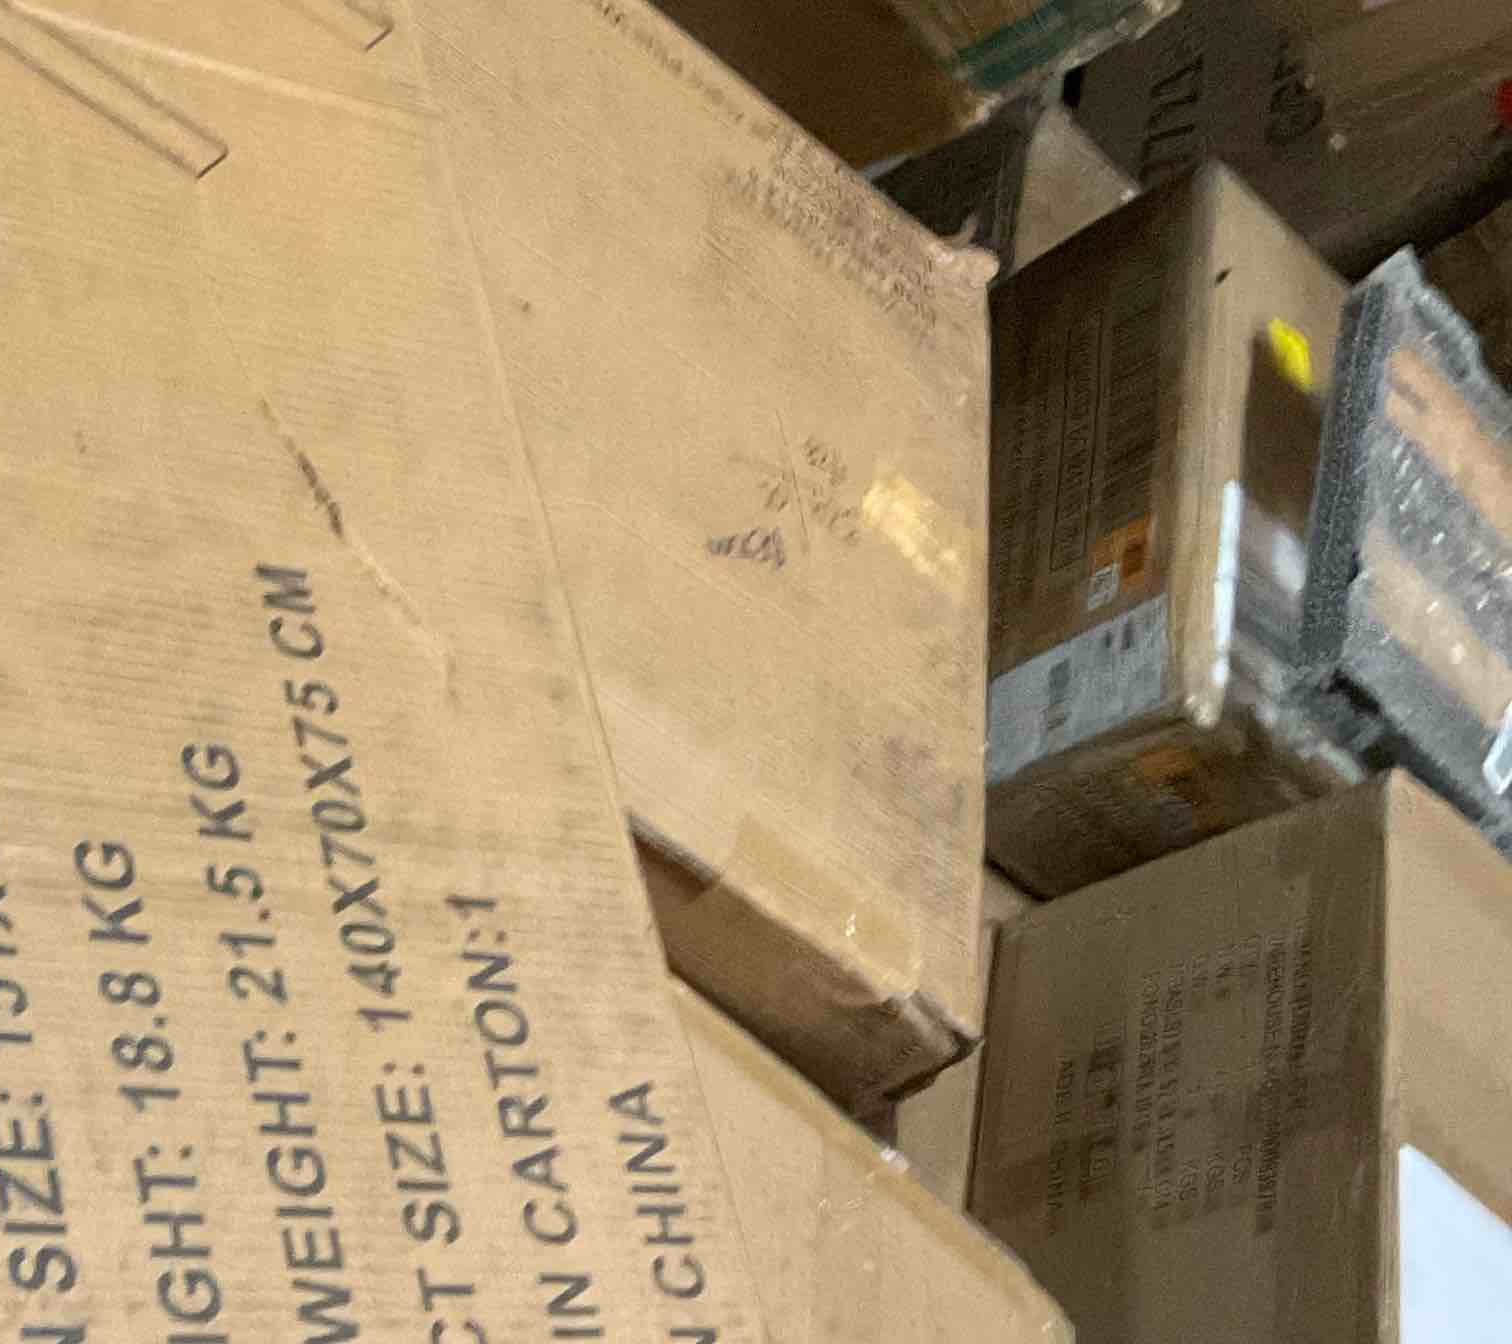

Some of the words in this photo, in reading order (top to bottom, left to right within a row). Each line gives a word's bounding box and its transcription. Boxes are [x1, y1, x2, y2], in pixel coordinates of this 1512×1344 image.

[254, 563, 325, 660] CM
[180, 742, 254, 842] KG
[284, 679, 412, 1034] 140X70X75
[73, 838, 150, 945] KG
[206, 862, 289, 1003] 21.5
[97, 970, 180, 1109] 18.8
[445, 893, 577, 1245] CARTON:1
[373, 1060, 462, 1245] SIZE:
[608, 1079, 707, 1298] CHINA
[538, 1271, 605, 1340] IN
